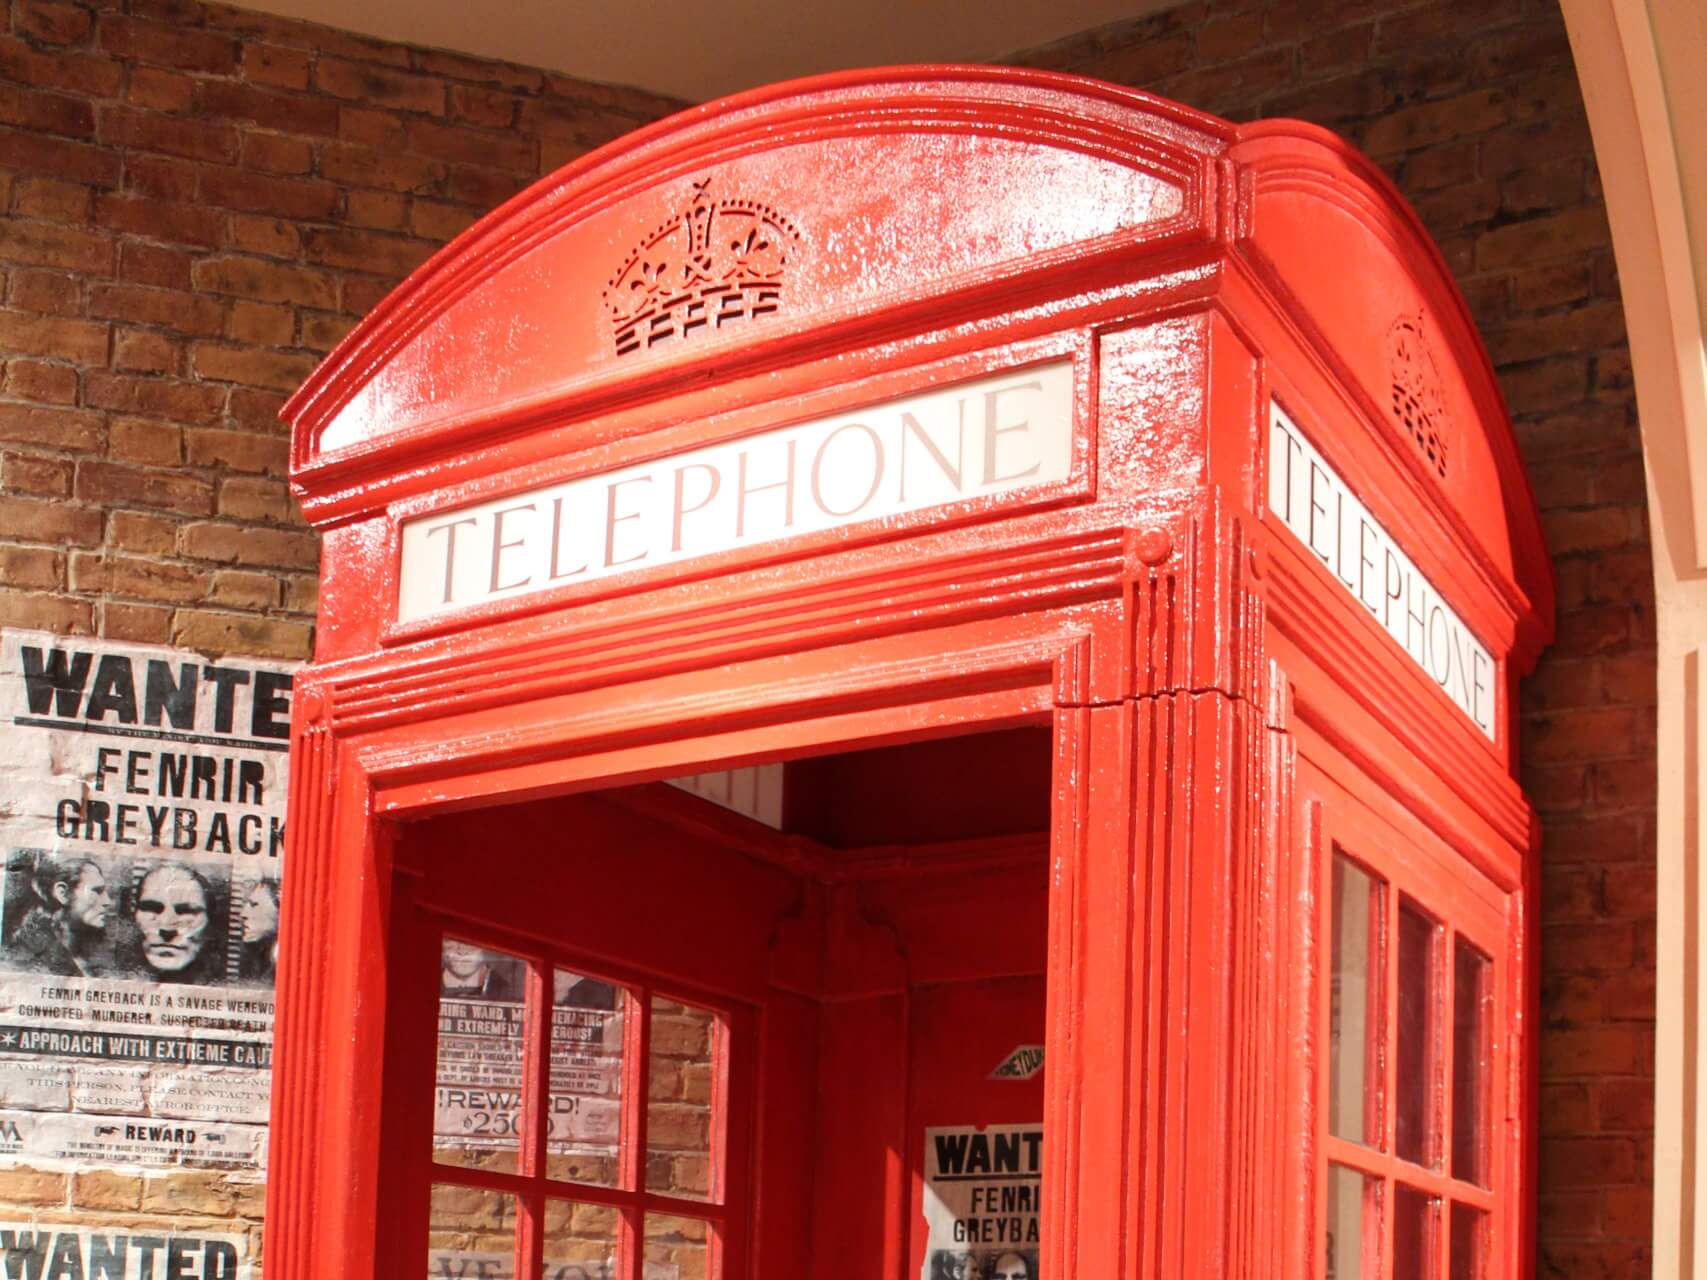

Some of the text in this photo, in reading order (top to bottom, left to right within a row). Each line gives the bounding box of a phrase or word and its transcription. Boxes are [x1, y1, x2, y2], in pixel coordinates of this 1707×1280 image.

[426, 380, 1043, 603] TELEPHONE
[1275, 420, 1487, 729] TELEPHONE
[95, 747, 265, 805] FENRIR
[18, 1004, 83, 1020] CONVICTED
[41, 987, 81, 1001] FENRIR
[86, 990, 145, 1005] GREYBACK
[150, 994, 161, 1007] IS
[166, 996, 173, 1008] A
[177, 997, 222, 1011] SAVAGE
[457, 1021, 520, 1036] EXTREMELY
[19, 1031, 103, 1054] APPROACH
[109, 1037, 150, 1057] WITH
[156, 1040, 229, 1062] EXTREME
[125, 1124, 196, 1144] REWARD
[934, 1132, 1043, 1174] WANT
[971, 1185, 1039, 1213] FENRI
[953, 1217, 1039, 1243] GREYBA
